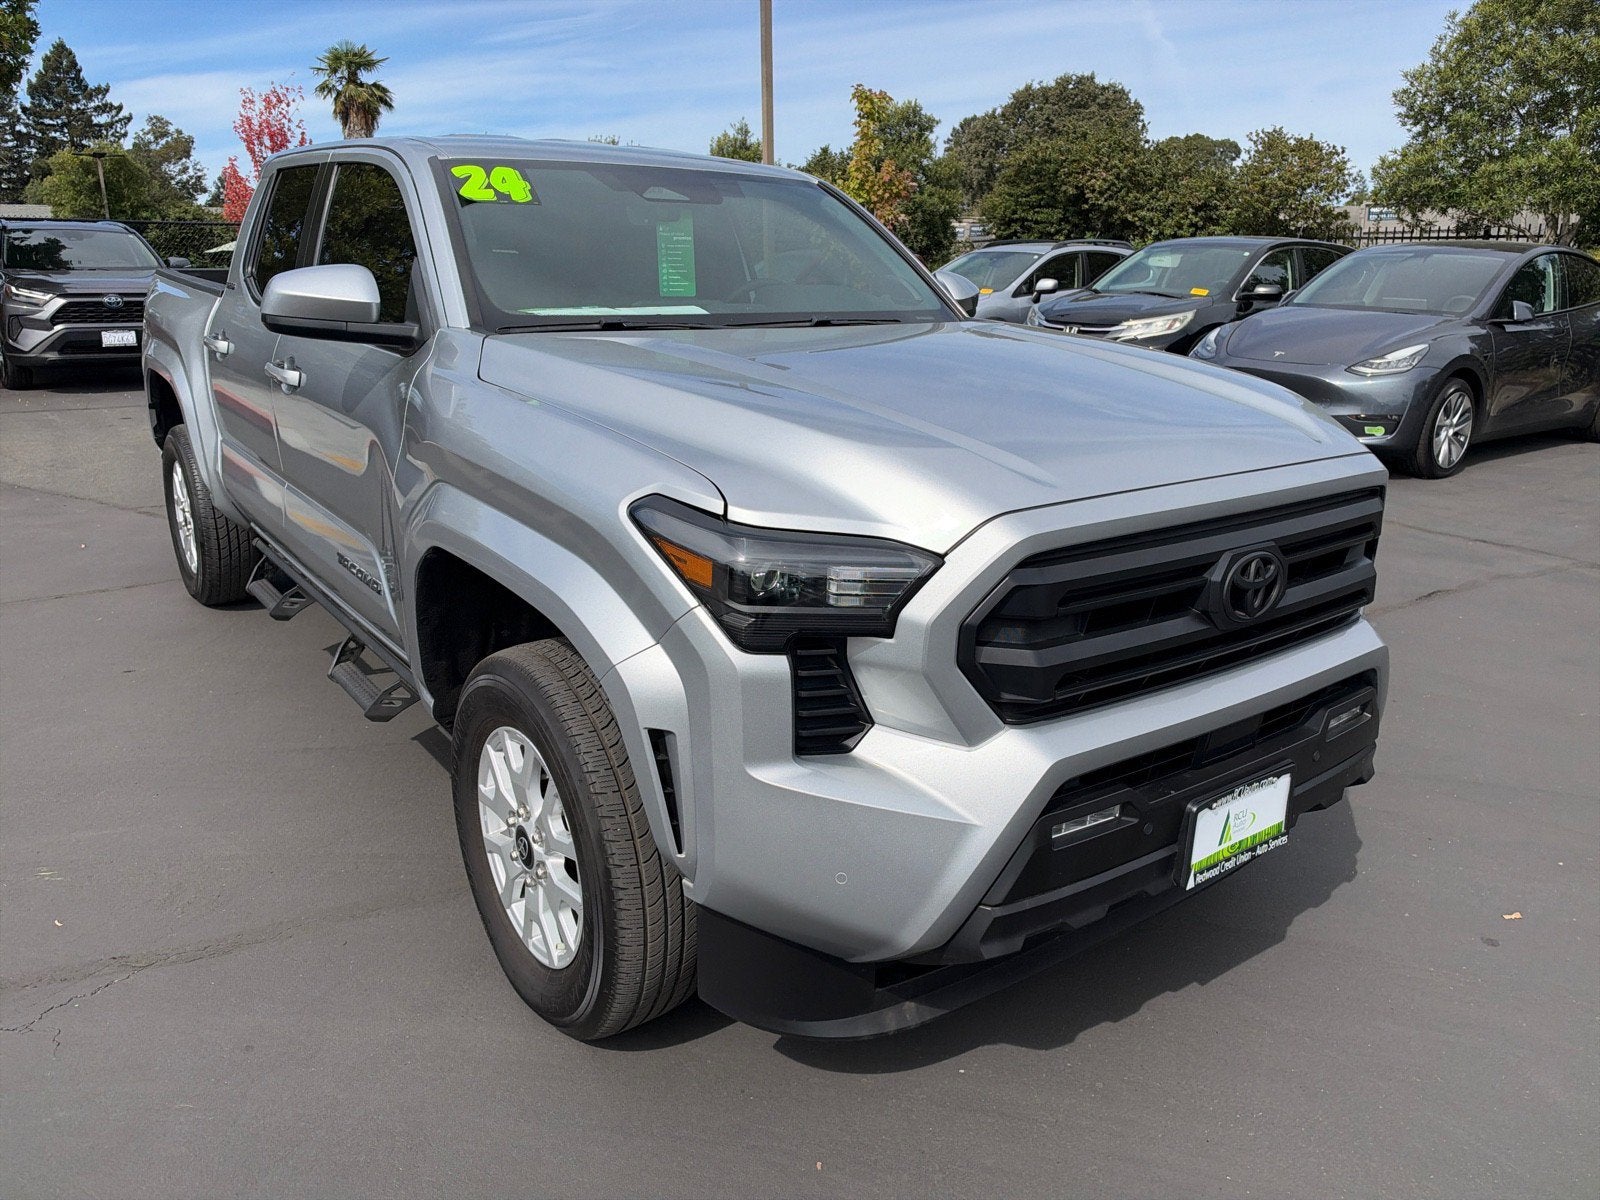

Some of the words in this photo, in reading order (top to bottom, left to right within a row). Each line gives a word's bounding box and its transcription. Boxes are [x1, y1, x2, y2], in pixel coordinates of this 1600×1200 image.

[450, 165, 532, 203] 24
[1233, 808, 1248, 822] RCU
[1195, 862, 1220, 886] Redwood
[1220, 856, 1236, 873] Credit
[1236, 851, 1252, 866] Union
[1255, 844, 1268, 857] Auto
[1268, 834, 1289, 851] Services
